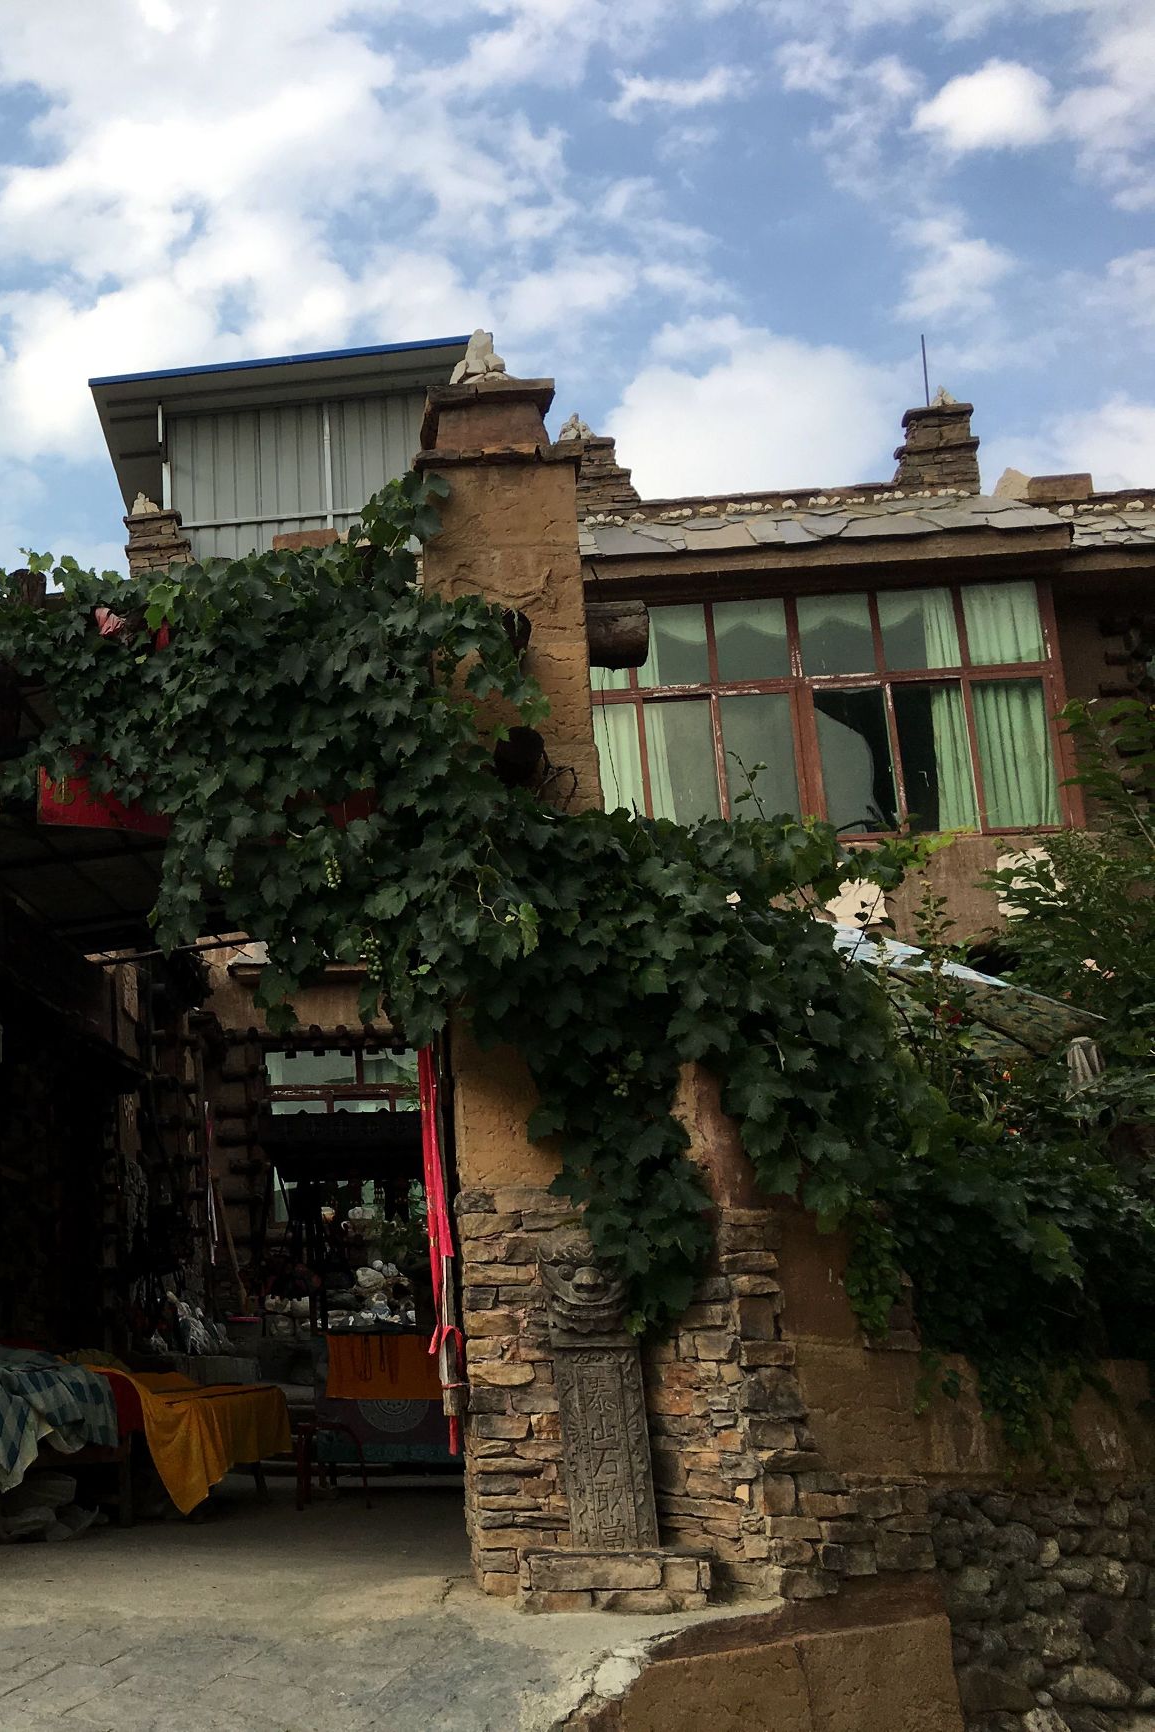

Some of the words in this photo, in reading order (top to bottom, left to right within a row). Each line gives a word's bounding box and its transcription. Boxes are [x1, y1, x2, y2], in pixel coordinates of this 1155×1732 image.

[586, 1377, 625, 1549] 泰山石敢當
